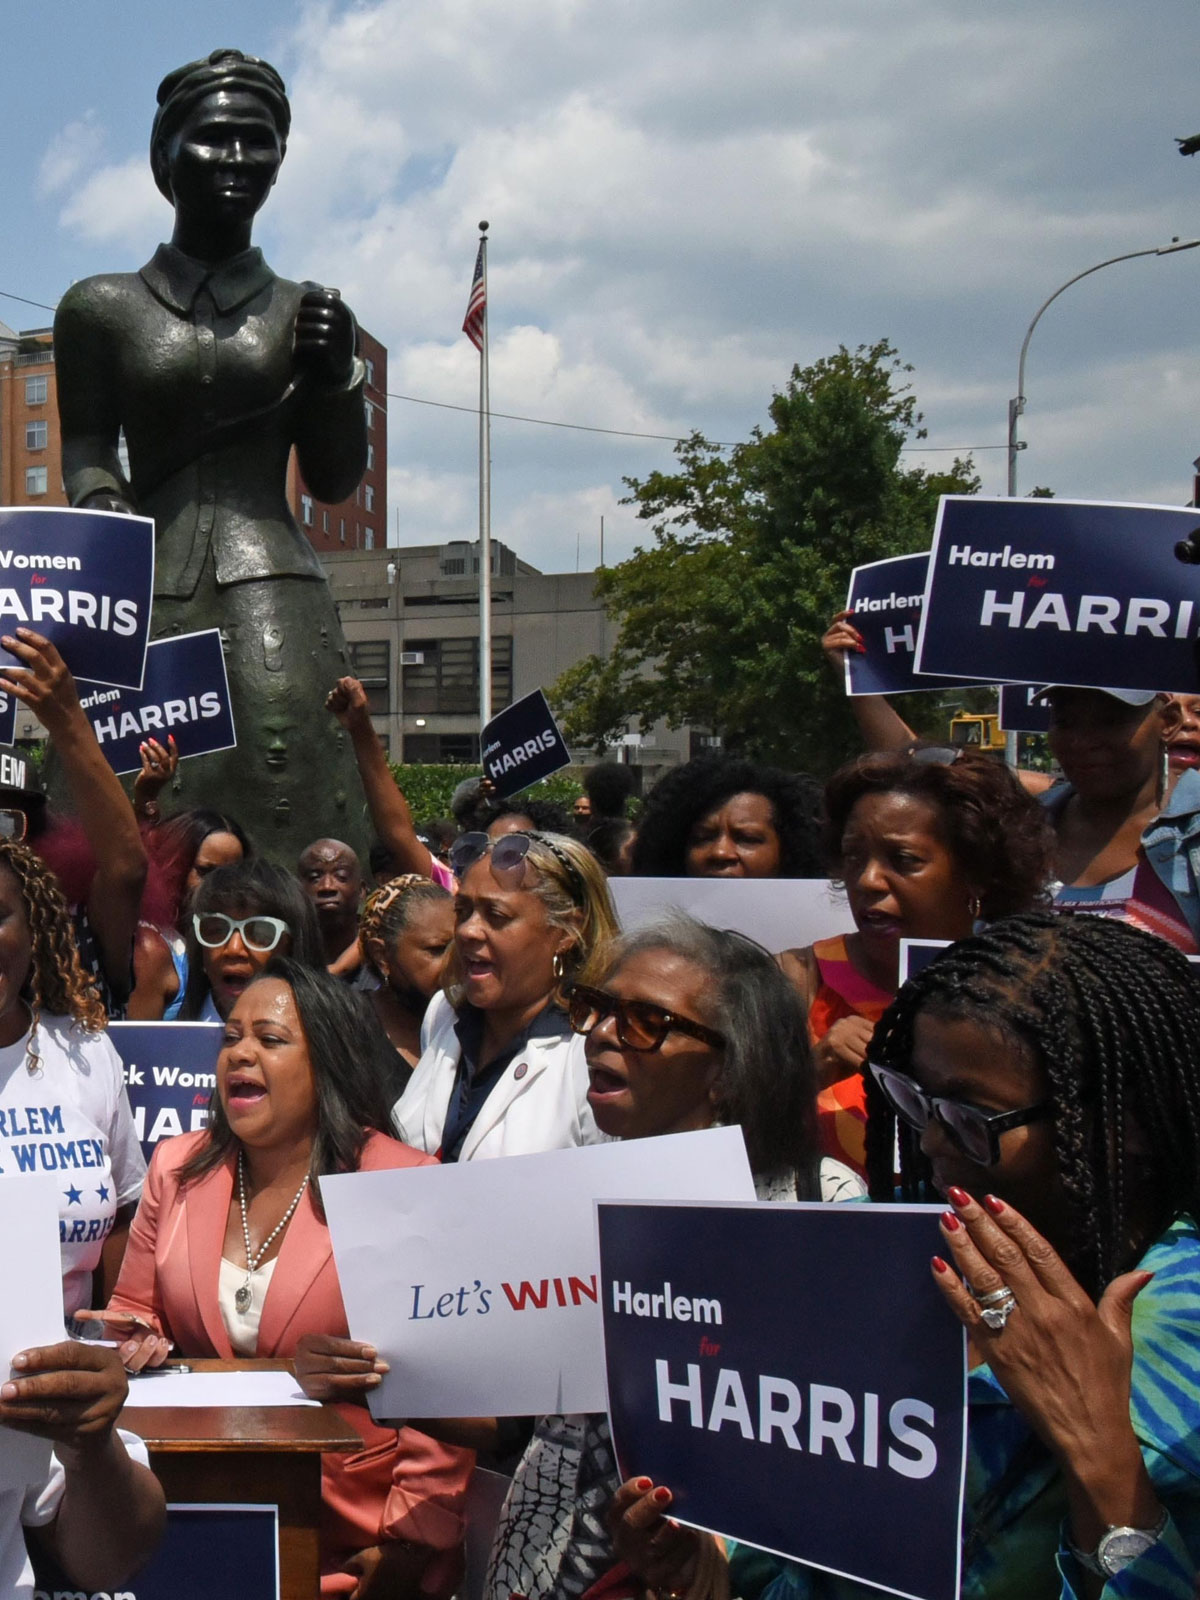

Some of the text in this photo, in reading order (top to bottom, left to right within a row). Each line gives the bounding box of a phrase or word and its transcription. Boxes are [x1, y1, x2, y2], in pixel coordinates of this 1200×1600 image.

[949, 545, 1055, 570] Harlem
[980, 590, 1199, 639] HARRI
[79, 689, 121, 709] arlem
[93, 692, 221, 744] HARRIS
[489, 729, 557, 778] HARRIS
[152, 1066, 216, 1088] Wom
[11, 1139, 105, 1173] WOMEN
[408, 1274, 598, 1320] Let's WIN
[613, 1280, 722, 1325] Harlem
[655, 1358, 938, 1480] HARRIS
